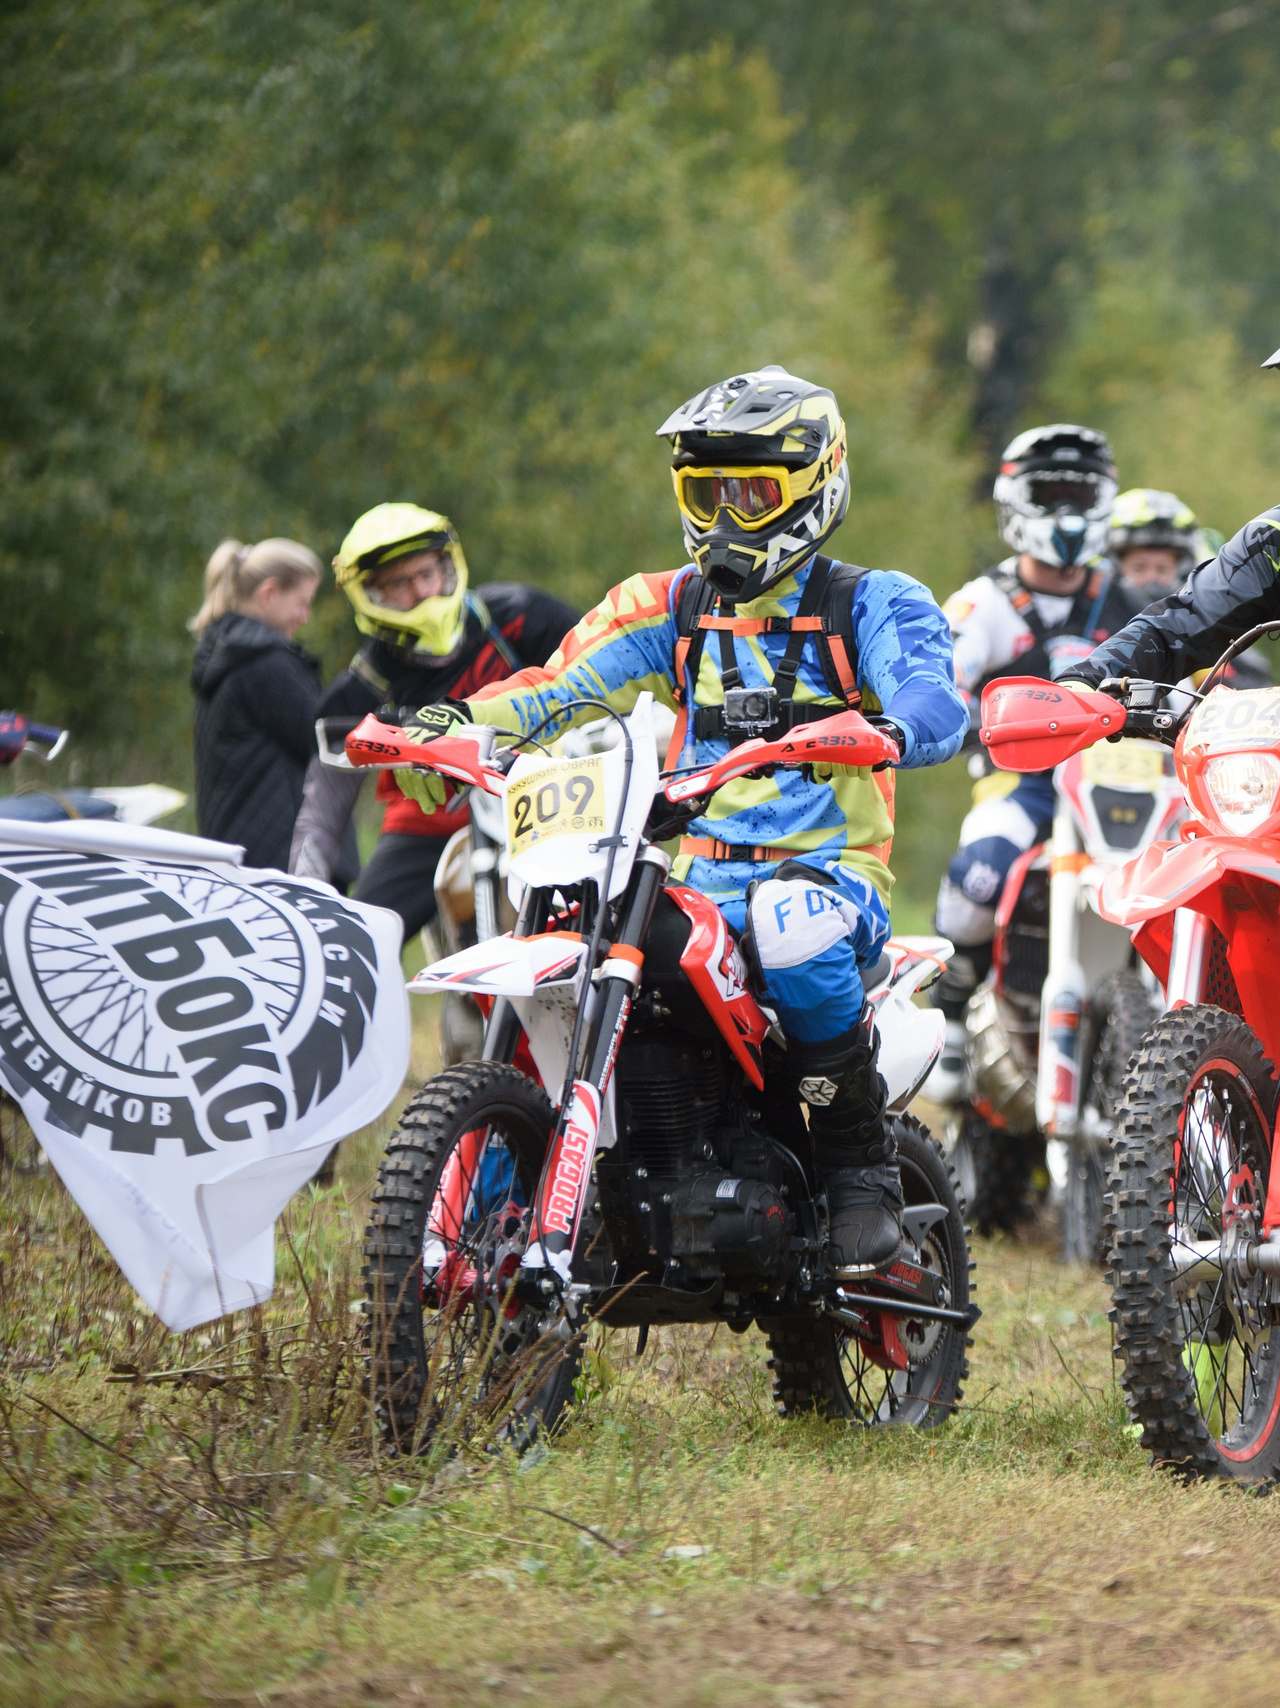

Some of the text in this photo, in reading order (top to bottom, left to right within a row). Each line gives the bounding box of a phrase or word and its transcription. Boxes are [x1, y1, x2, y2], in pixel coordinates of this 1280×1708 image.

[346, 739, 401, 757] CERBIS
[561, 756, 604, 772] ОВРАГ
[514, 775, 595, 839] 209
[544, 1123, 589, 1235] PROGASI
